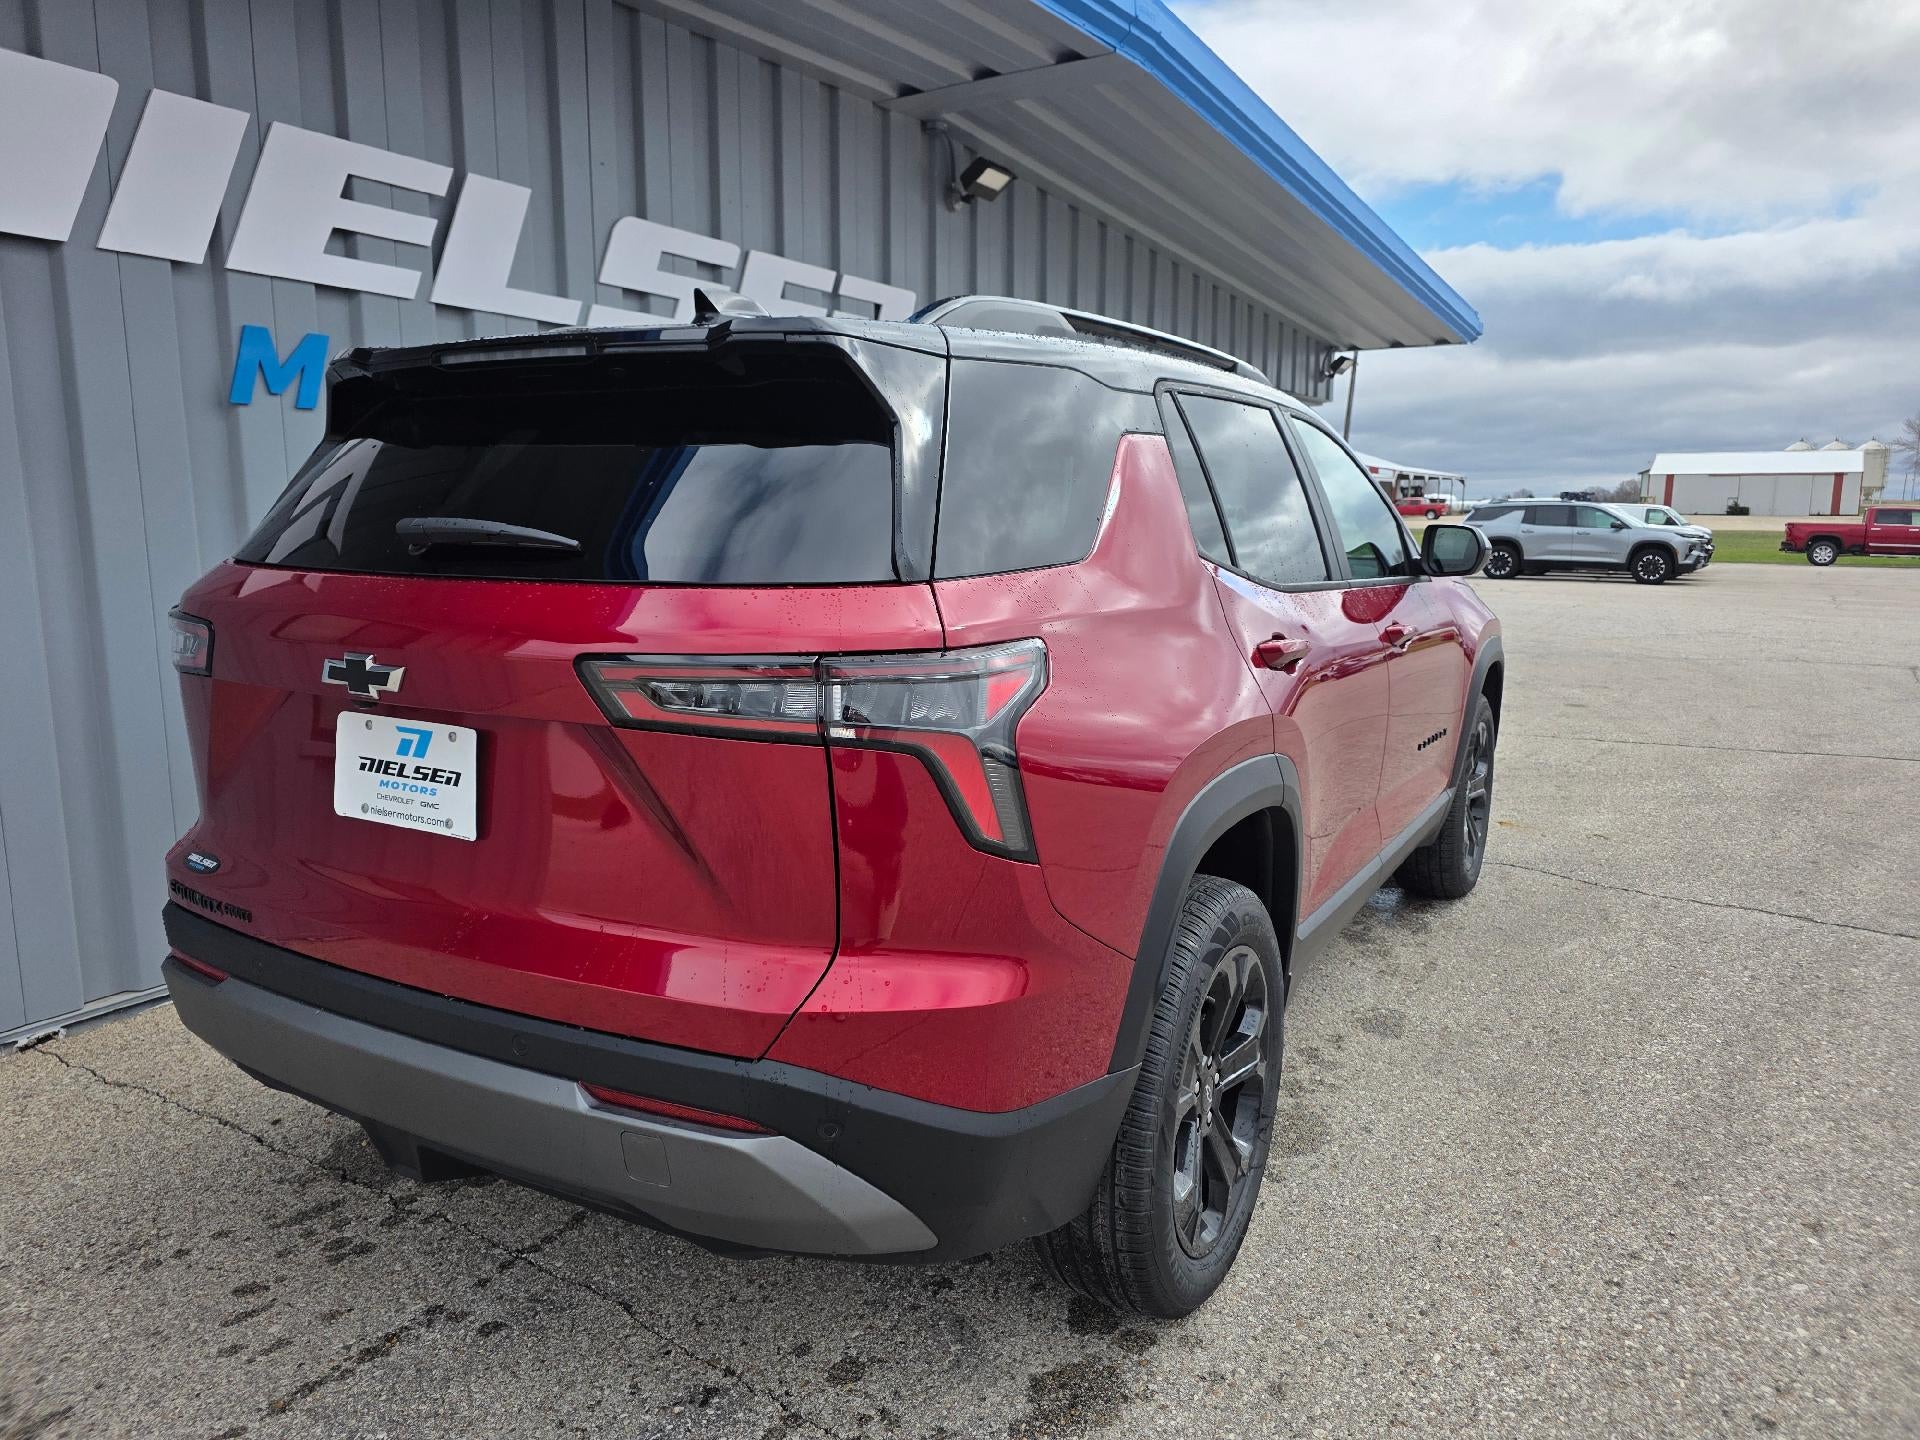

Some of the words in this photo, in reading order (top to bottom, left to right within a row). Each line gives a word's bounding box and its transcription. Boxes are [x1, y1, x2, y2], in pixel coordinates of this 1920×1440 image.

[358, 756, 462, 787] NIELSEN
[379, 780, 438, 796] MOTORS
[376, 793, 415, 805] CHEVROLET
[420, 801, 440, 810] GMC
[370, 805, 445, 827] nielsenmotors.com
